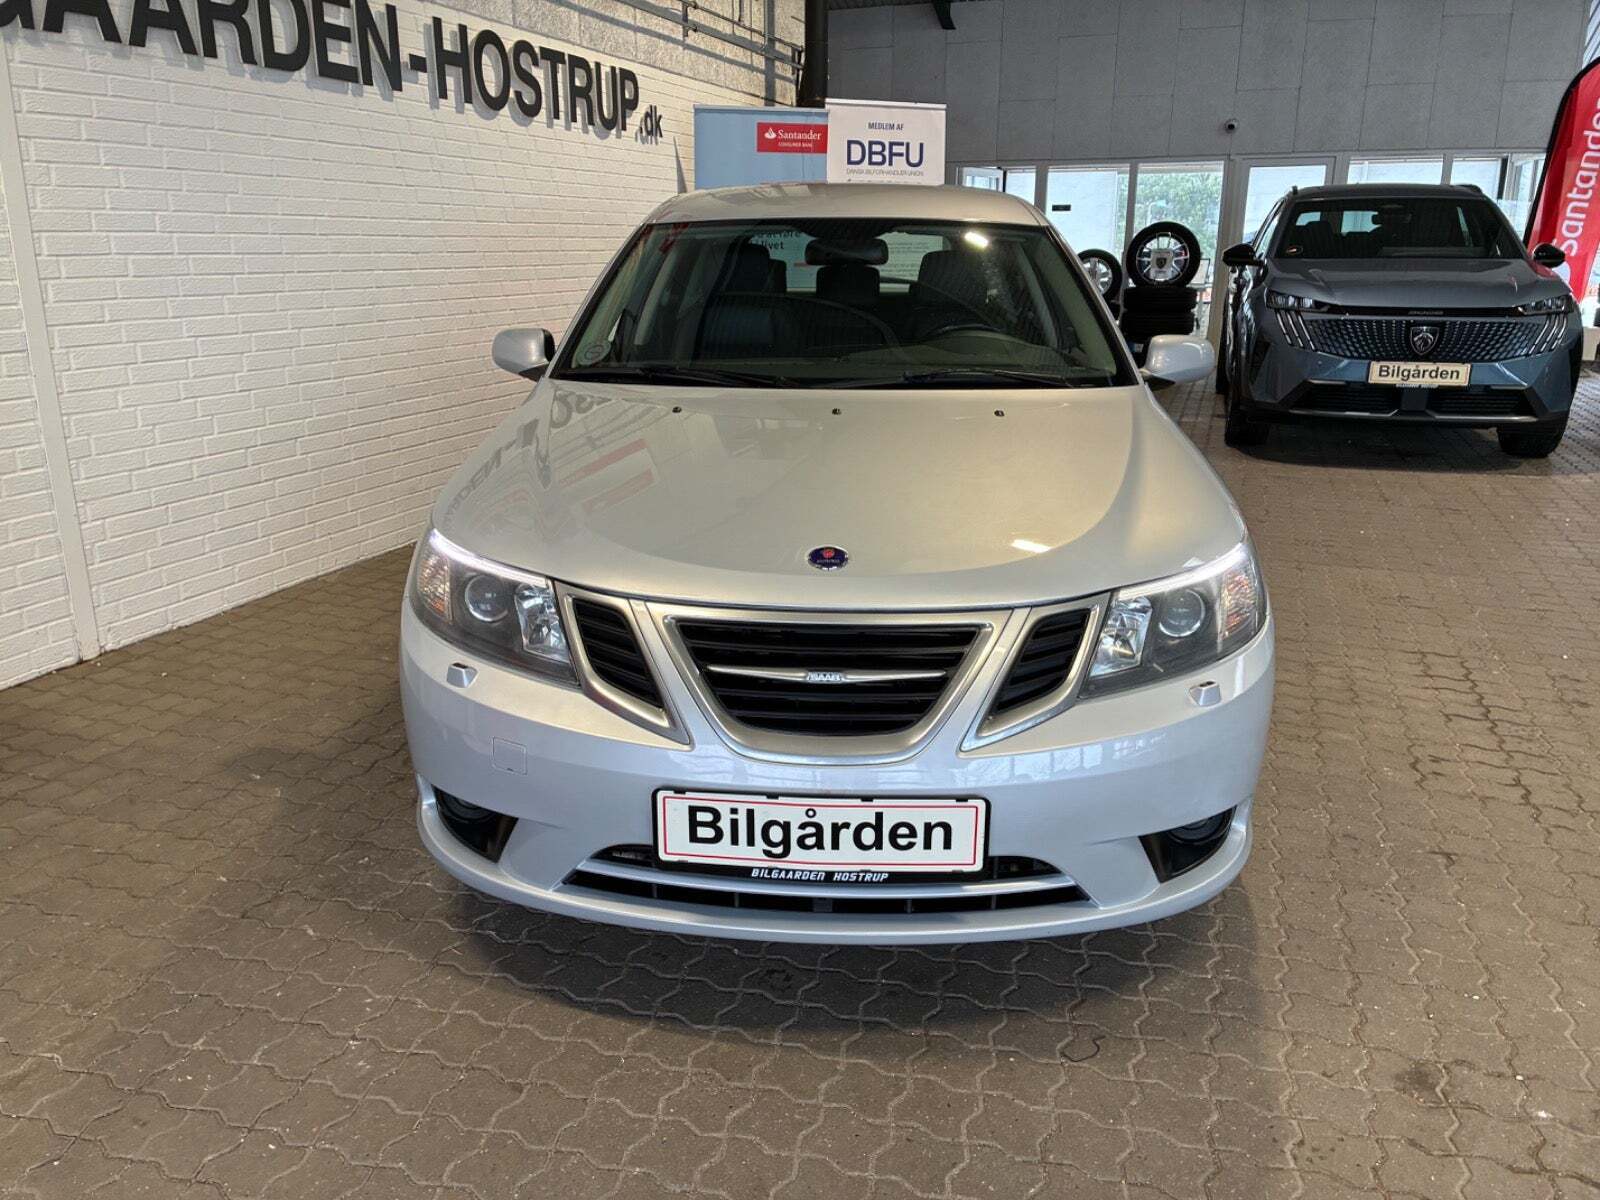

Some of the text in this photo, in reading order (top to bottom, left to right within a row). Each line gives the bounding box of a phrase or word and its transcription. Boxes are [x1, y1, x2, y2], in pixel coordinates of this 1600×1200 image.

[777, 129, 822, 140] Santander
[867, 121, 905, 131] MEDLEM AF
[846, 139, 924, 168] DBFU
[1553, 97, 1600, 257] Santand
[1378, 364, 1460, 382] Bilgården
[687, 804, 952, 859] Bilgården
[751, 867, 889, 883] BILGAARDEN HOSTRUP
